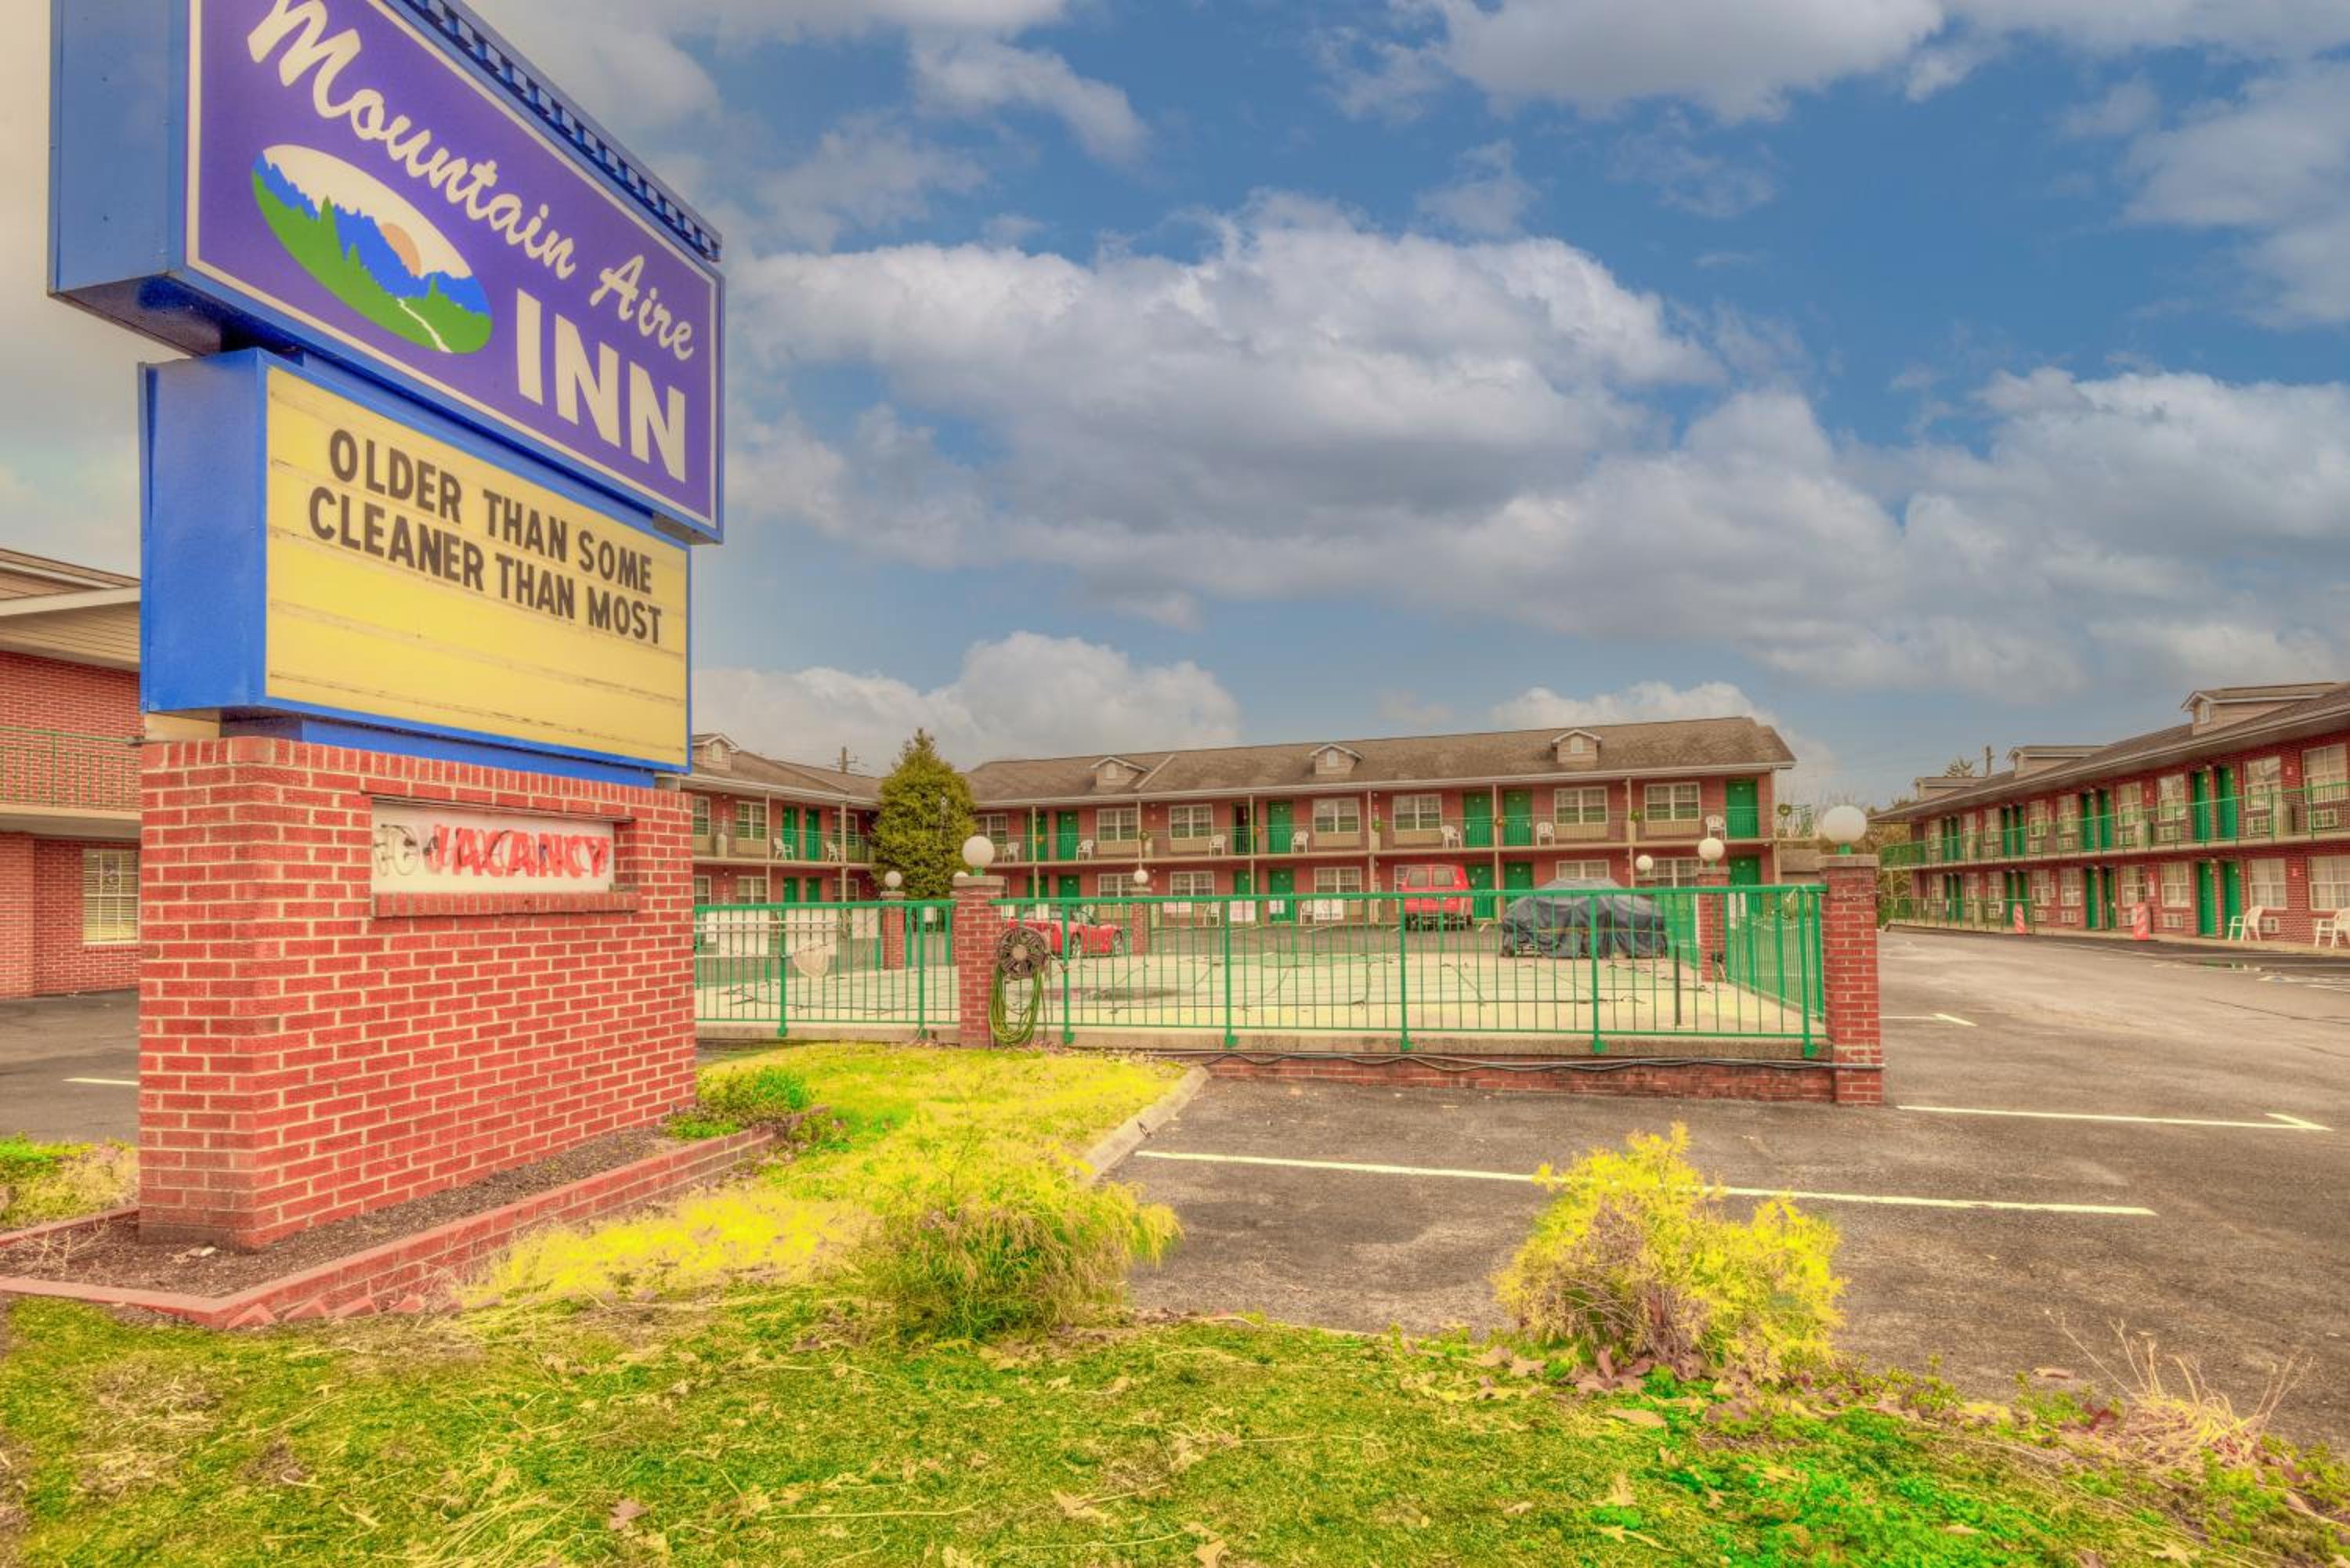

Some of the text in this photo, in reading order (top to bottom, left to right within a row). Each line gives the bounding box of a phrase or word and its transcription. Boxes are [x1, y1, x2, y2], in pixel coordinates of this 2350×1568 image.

[247, 0, 694, 360] Mountain Aire
[517, 287, 685, 483] INN
[309, 486, 662, 645] CLEANER THAN MOST
[330, 429, 653, 594] OLDER THAN SOME
[427, 825, 609, 879] VACANCY
